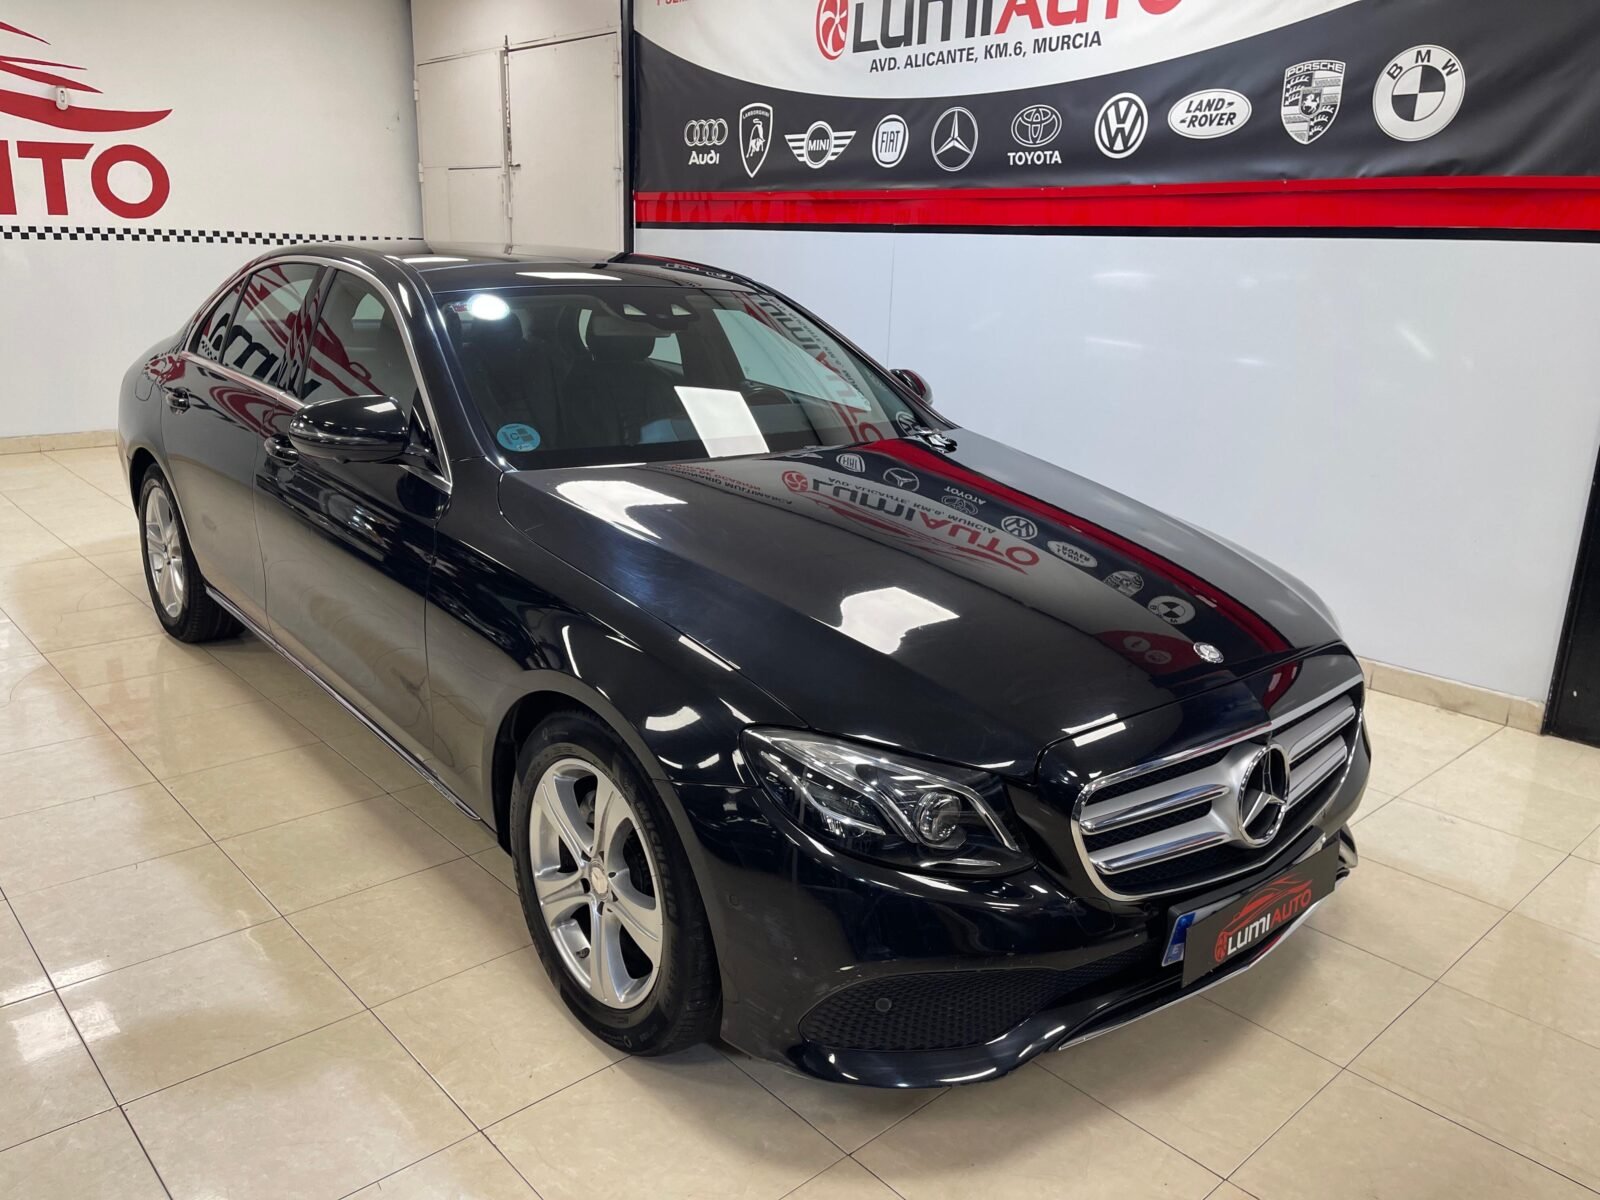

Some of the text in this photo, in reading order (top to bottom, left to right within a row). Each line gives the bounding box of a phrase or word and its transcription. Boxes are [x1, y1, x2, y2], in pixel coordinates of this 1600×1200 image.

[869, 30, 1102, 73] AVD. ALICANTE, KM.6, MURCIA
[1287, 62, 1343, 77] PORSCHE
[1186, 98, 1223, 114] LAND
[1187, 112, 1237, 128] ROVER
[807, 138, 830, 151] MINI
[880, 130, 901, 153] FIAT
[688, 150, 720, 165] Audi
[1007, 150, 1062, 166] TOYOTA
[1226, 888, 1313, 956] LUMIAUTO
